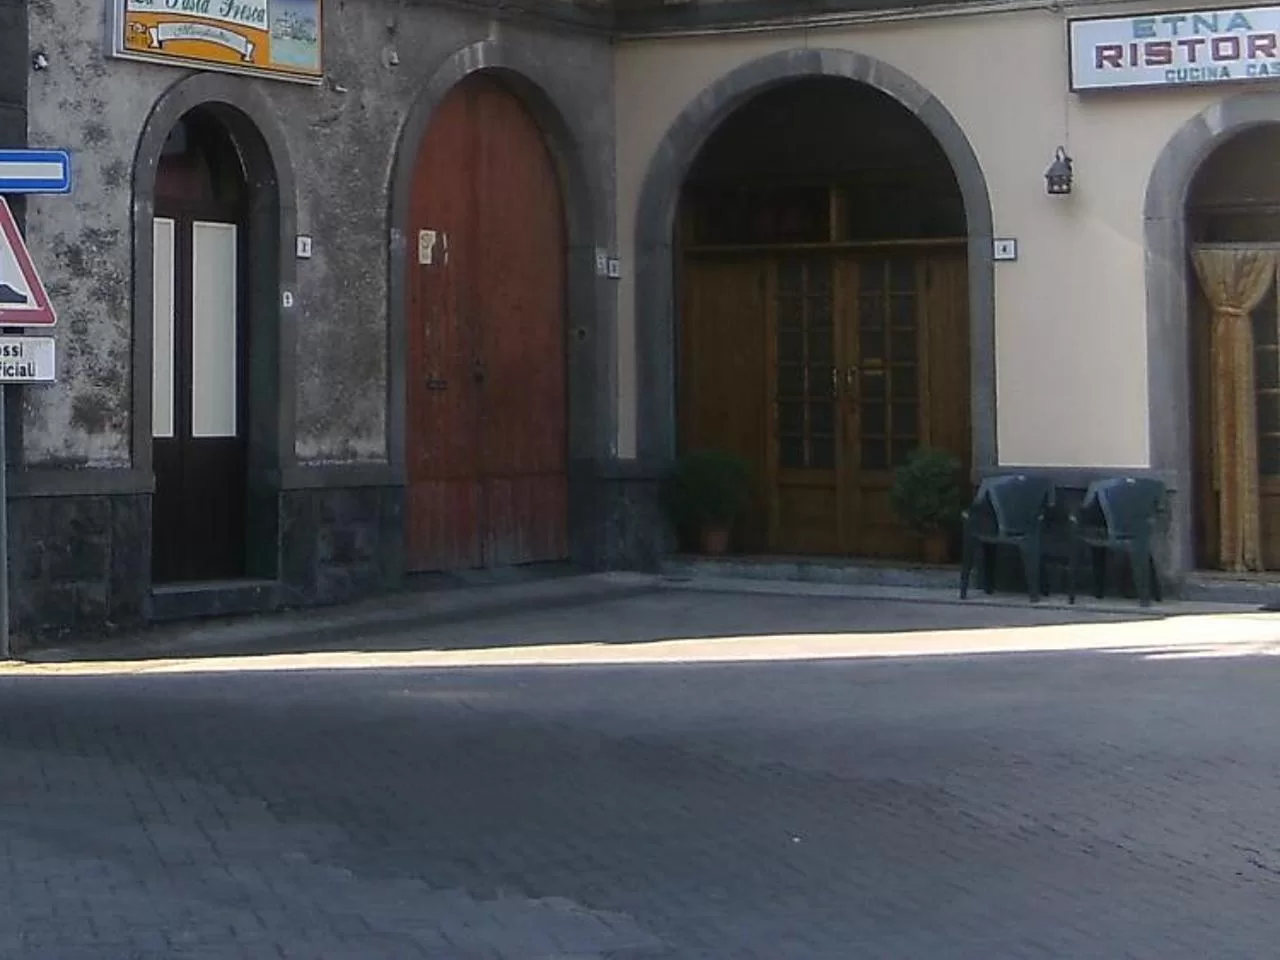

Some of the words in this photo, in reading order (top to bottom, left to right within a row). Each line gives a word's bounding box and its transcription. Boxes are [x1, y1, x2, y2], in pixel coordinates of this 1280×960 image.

[1132, 12, 1252, 38] ETNA
[1095, 33, 1277, 69] RISTOR
[1165, 66, 1231, 82] CUCINA
